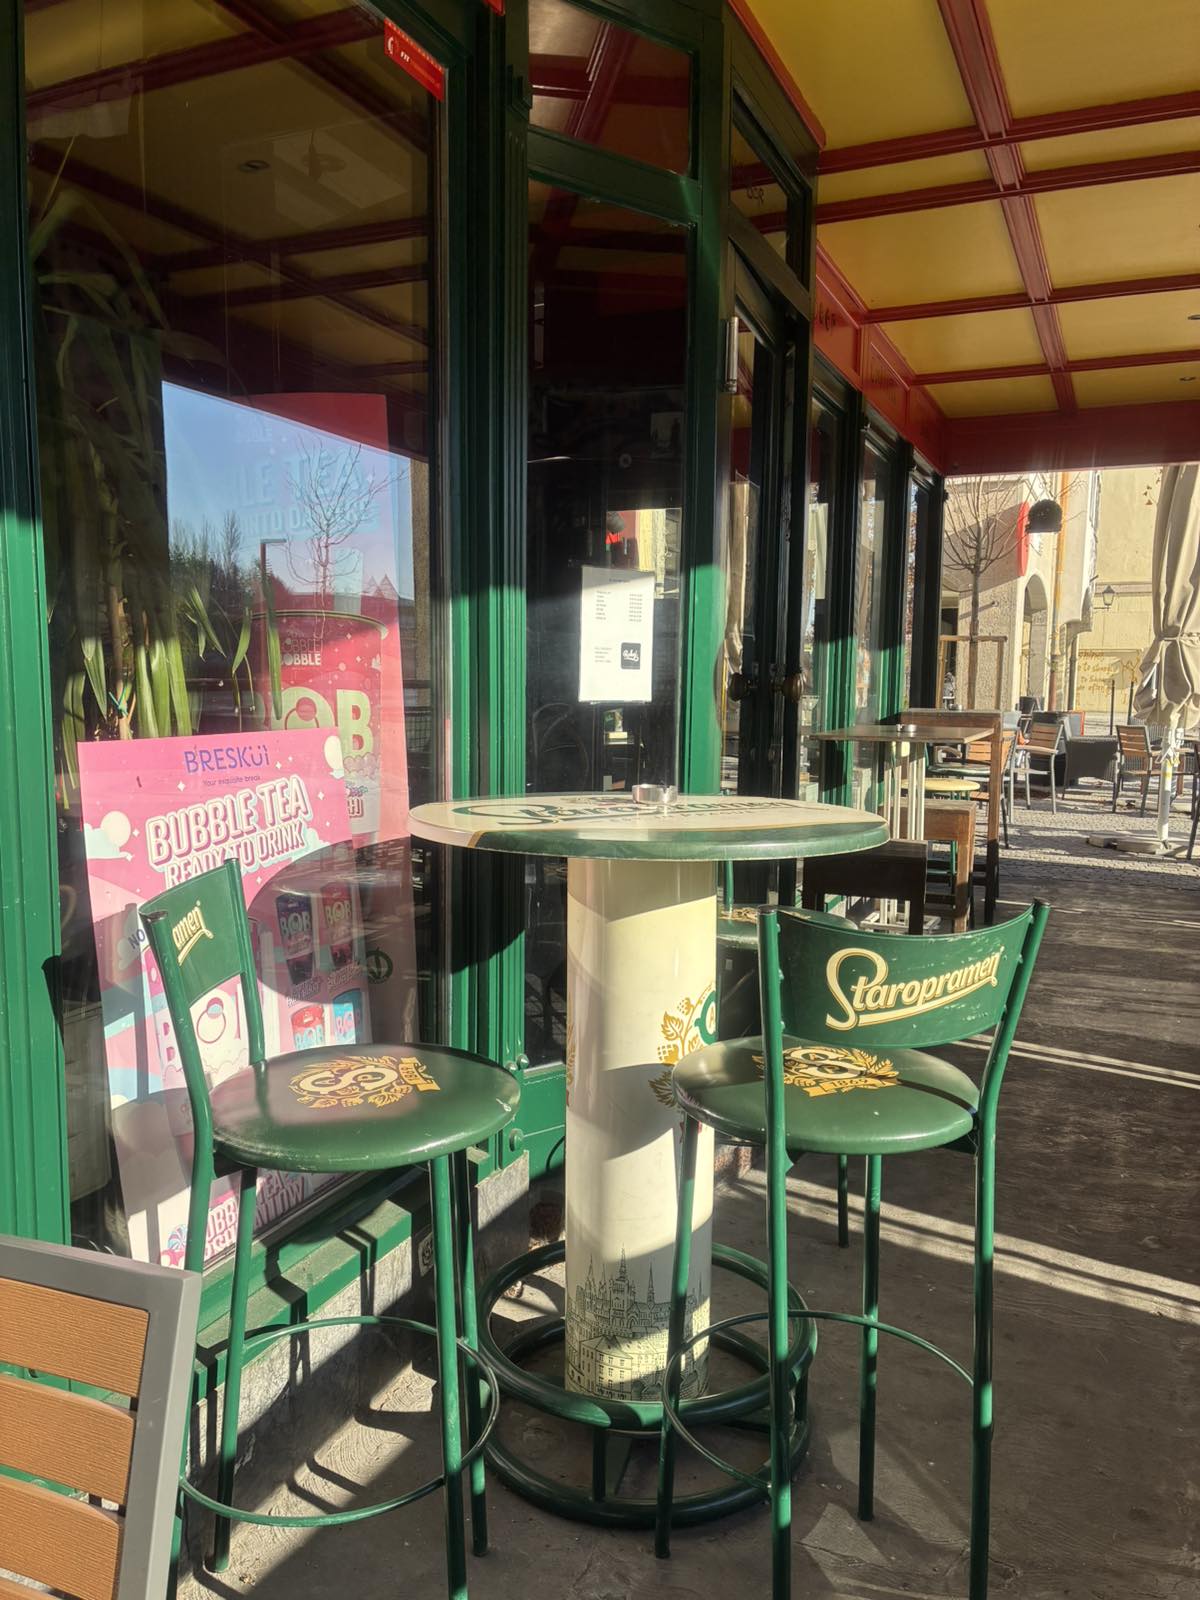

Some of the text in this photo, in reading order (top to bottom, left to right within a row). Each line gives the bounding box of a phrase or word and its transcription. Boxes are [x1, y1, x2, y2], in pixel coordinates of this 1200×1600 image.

[146, 790, 257, 866] BUBBLE
[257, 776, 309, 826] TEA
[257, 820, 306, 862] DRINK
[825, 945, 1005, 1031] Staropramen
[831, 1078, 868, 1088] 1869
